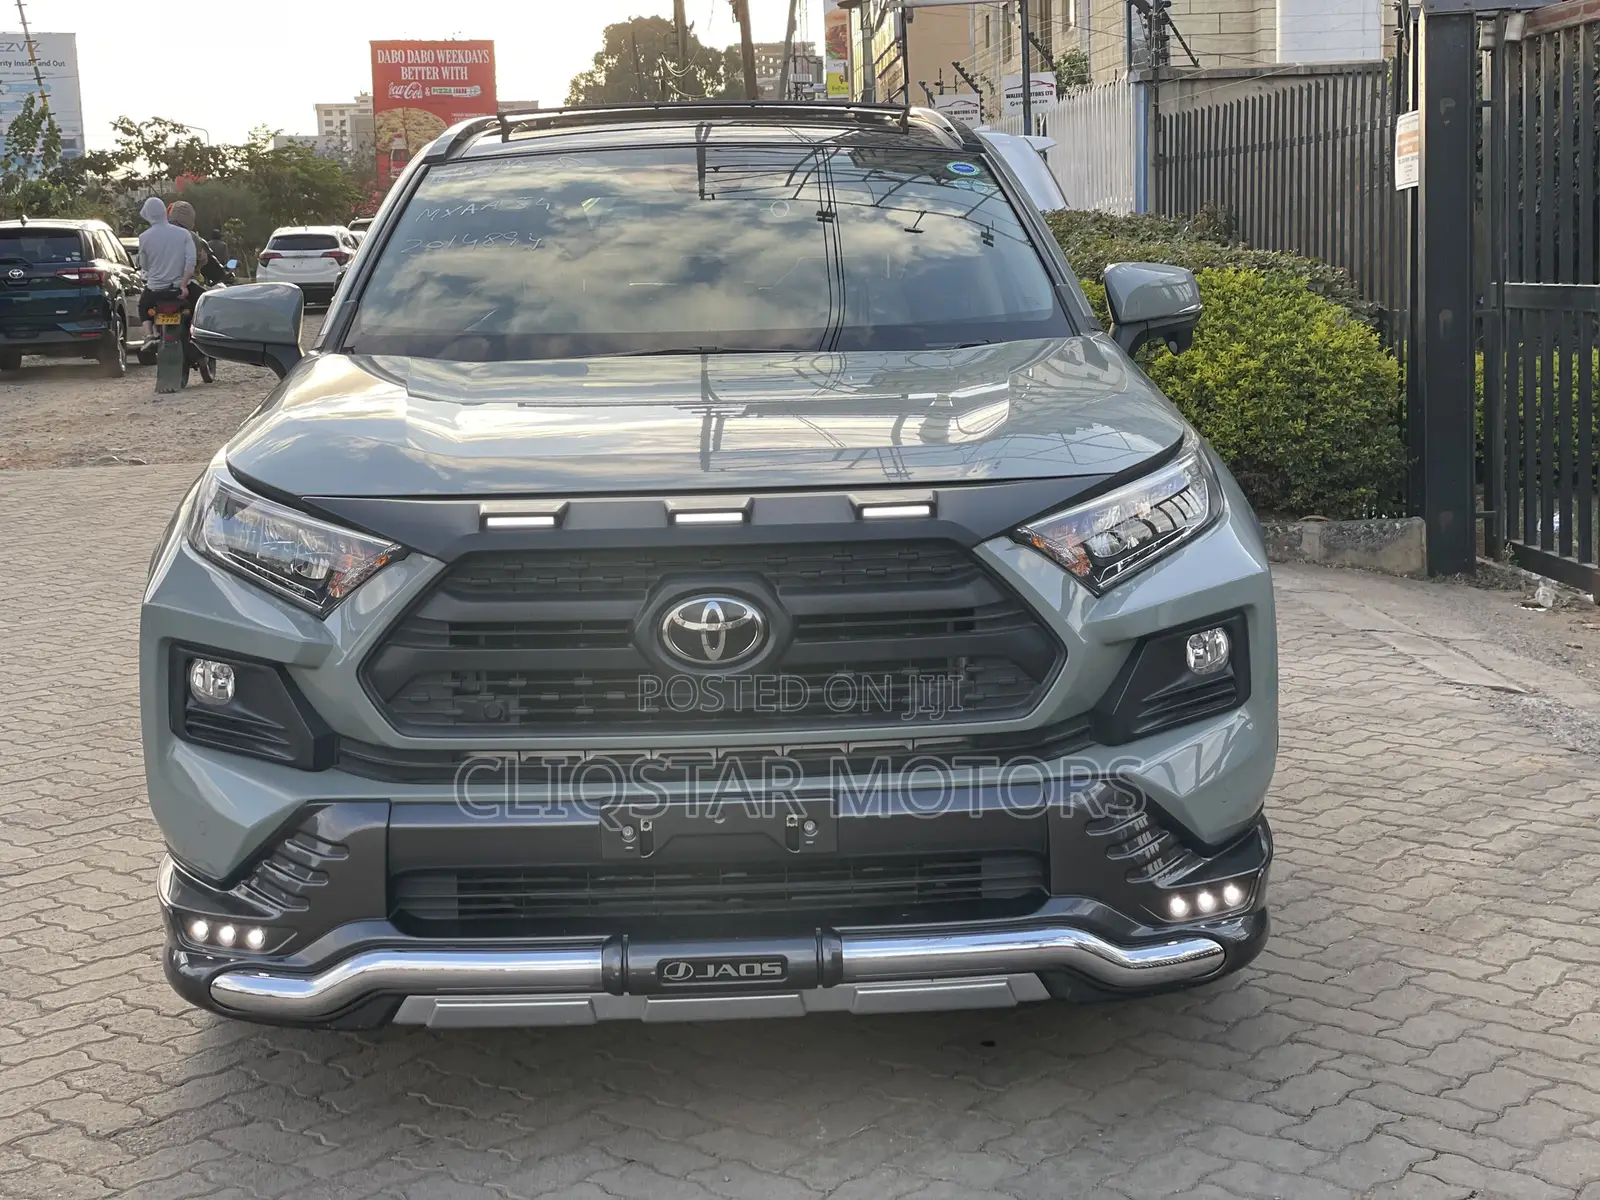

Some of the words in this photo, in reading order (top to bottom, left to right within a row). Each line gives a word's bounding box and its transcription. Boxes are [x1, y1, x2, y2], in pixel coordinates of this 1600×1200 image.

[0, 43, 41, 52] EZVZ
[377, 49, 405, 64] DABO
[407, 49, 435, 64] DABO
[437, 49, 490, 64] WEEKDAYS
[401, 66, 440, 80] BETTER
[441, 66, 468, 80] WITH
[696, 962, 782, 978] JAOS
